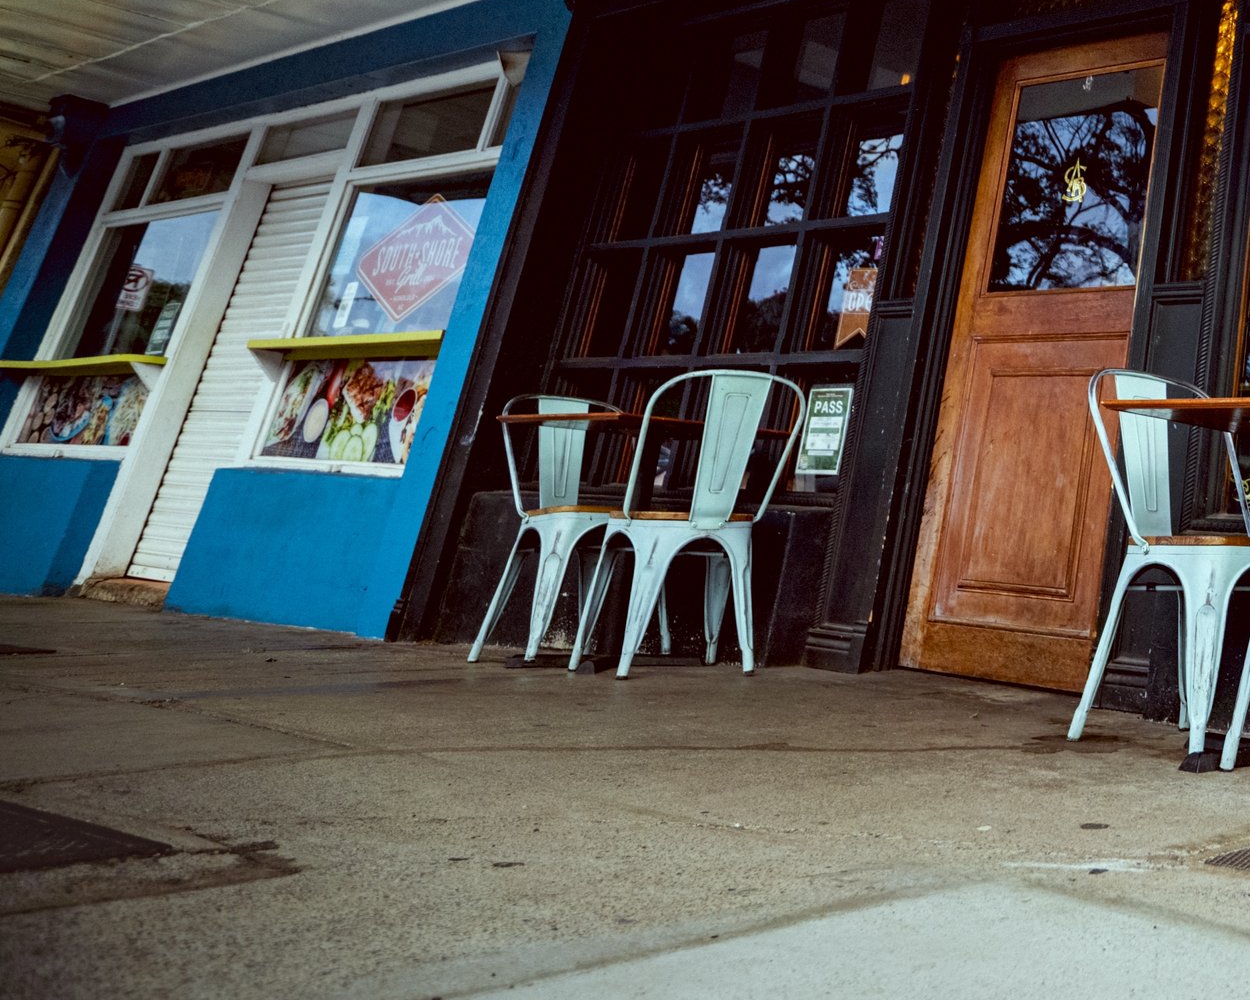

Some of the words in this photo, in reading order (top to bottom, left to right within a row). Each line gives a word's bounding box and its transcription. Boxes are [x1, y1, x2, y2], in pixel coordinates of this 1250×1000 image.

[372, 241, 418, 277] SOUTH
[421, 236, 464, 270] SHORE
[814, 400, 843, 414] PASS
